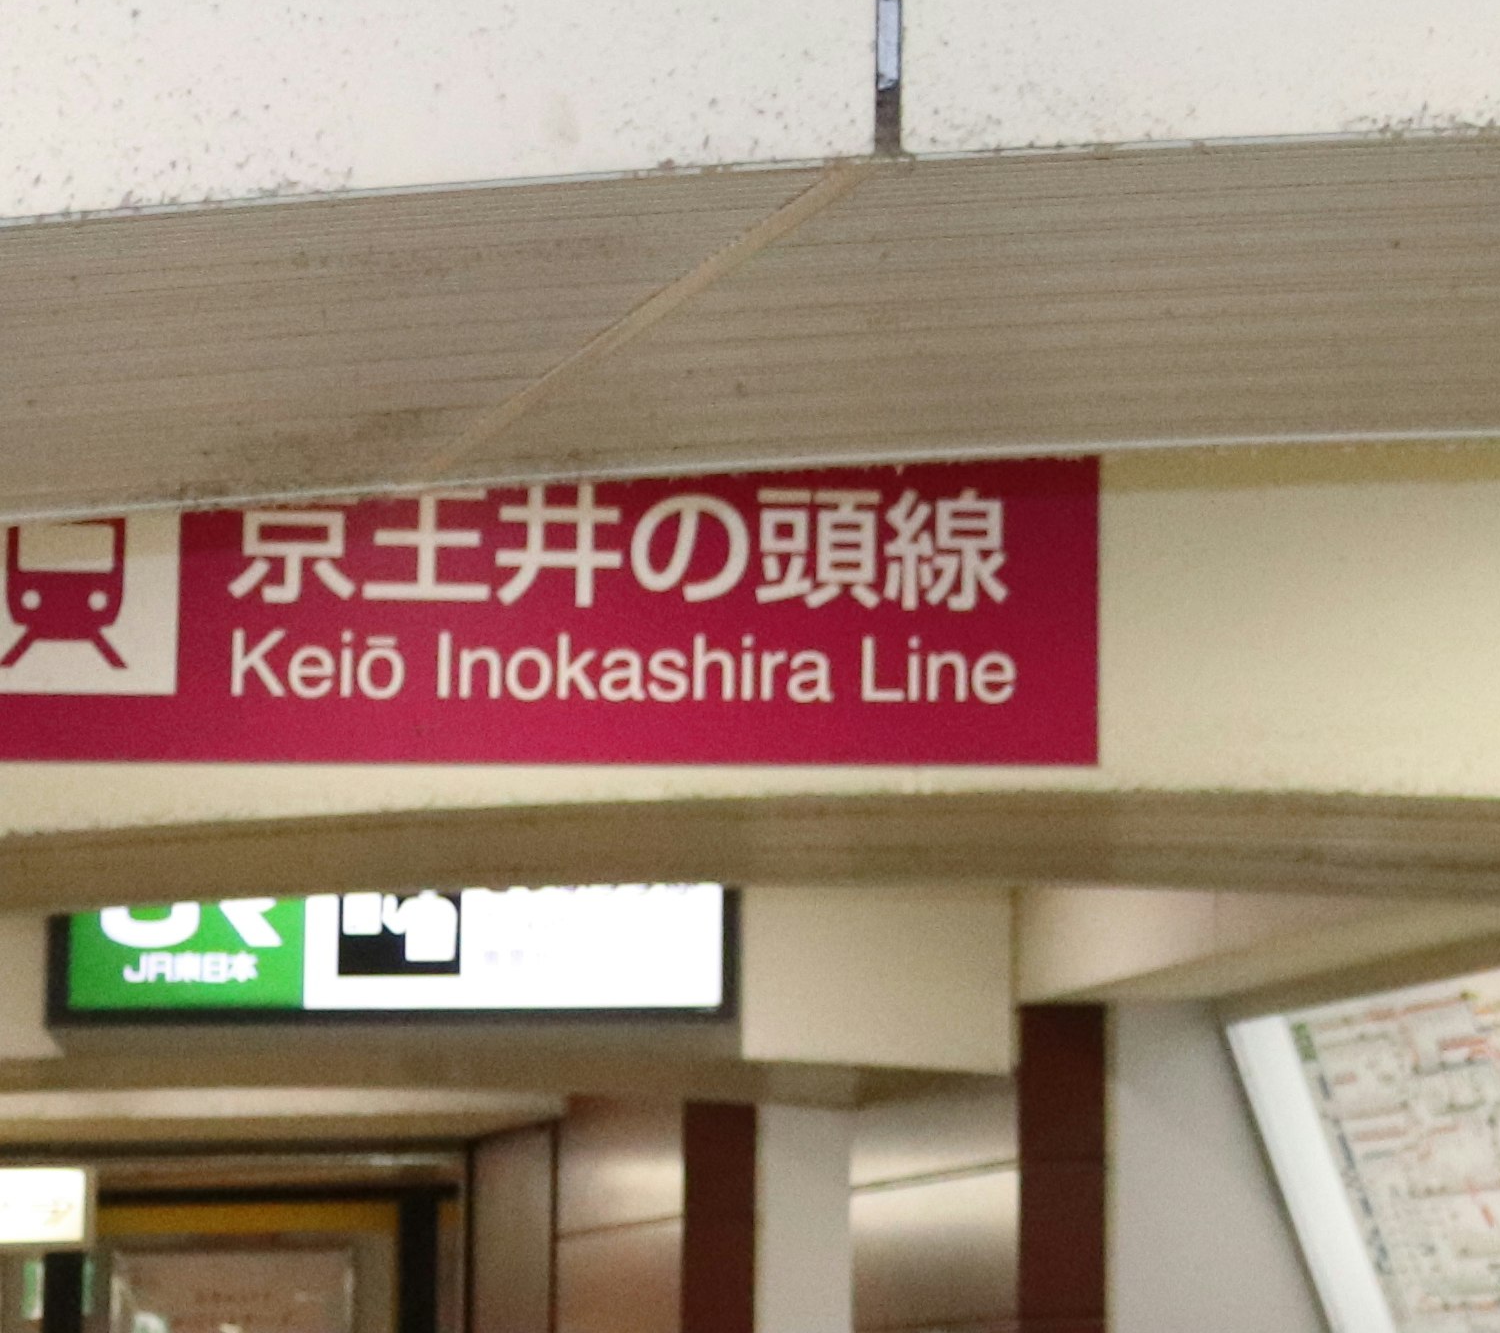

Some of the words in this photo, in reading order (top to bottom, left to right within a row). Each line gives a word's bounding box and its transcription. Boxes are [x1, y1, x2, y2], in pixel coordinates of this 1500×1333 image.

[227, 483, 1009, 612] 京王井の頭線
[229, 627, 406, 701] Keiō
[436, 630, 835, 705] Inokashira
[860, 633, 1018, 705] Line
